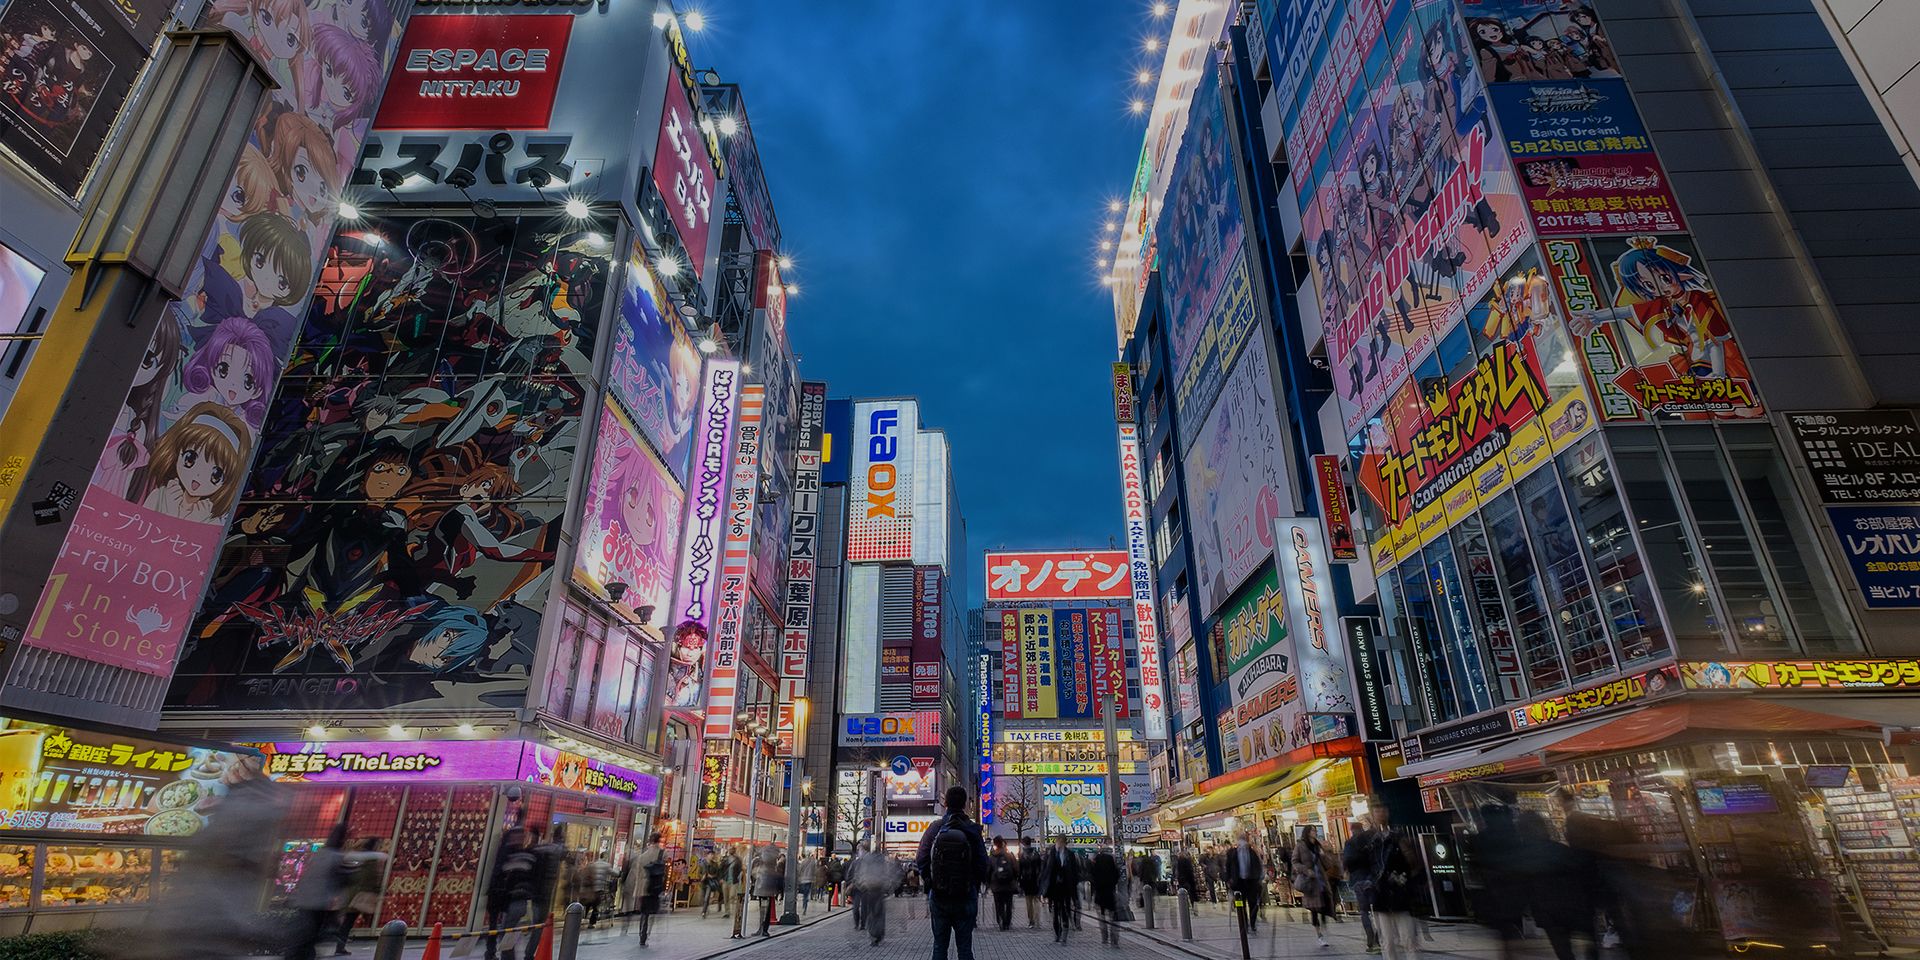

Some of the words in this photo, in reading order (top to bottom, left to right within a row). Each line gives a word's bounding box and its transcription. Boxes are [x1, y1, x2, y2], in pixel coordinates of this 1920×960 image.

[405, 48, 550, 72] ESPACE
[419, 80, 521, 97] NITTAKU
[1528, 115, 1613, 126] ブースターパック
[1530, 128, 1568, 138] BanG
[1572, 126, 1621, 137] Dream!
[1510, 136, 1648, 154] 5月26日(金)発売!
[1531, 195, 1669, 214] 事前登録受付中!
[1538, 213, 1603, 227] 2017年春
[1609, 212, 1675, 225] 配信予定!
[813, 385, 824, 428] HOBBY
[1636, 378, 1752, 408] カードキングダム
[799, 384, 813, 448] PARADISE
[1792, 415, 1838, 425] 不動産の
[1799, 424, 1915, 436] トータルコンサルタント
[738, 425, 757, 466] 買取り
[1380, 341, 1548, 523] カードキングダム
[1122, 444, 1142, 518] TAKARADA
[1865, 489, 1920, 499] 03-6206-9
[1866, 473, 1886, 485] 8F
[731, 487, 751, 537] まっくす
[1847, 534, 1920, 555] レオパレ
[132, 561, 193, 600] BOX
[923, 570, 940, 603] Duty
[991, 553, 1129, 593] オノデン
[1132, 561, 1151, 600] 免税商店
[80, 584, 111, 613] In
[1290, 526, 1329, 655] GAMERS
[67, 613, 166, 660] Stores
[716, 576, 741, 668] アキバ駅前店
[923, 605, 940, 638] Free
[1003, 613, 1017, 642] 免税
[1136, 603, 1160, 687] 歓迎光臨
[1356, 624, 1367, 651] AKIBA
[1004, 643, 1018, 672] TAX
[1243, 655, 1284, 690] AKIHABARA
[1360, 653, 1373, 680] STORE
[980, 654, 989, 706] Panasonic
[1005, 674, 1019, 713] FREE
[1237, 674, 1299, 727] GAMERS
[1364, 681, 1382, 732] ALIENWARE
[1544, 678, 1644, 719] カードキングダム
[982, 712, 991, 757] ONODEN
[1010, 732, 1031, 741] TAX
[1034, 732, 1061, 741] FREE
[1064, 731, 1089, 741] 免税店
[1428, 728, 1460, 745] ALIENWARE
[1460, 724, 1480, 738] STORE
[1481, 719, 1502, 733] AKIBA
[68, 743, 194, 773] 銀座ライオン
[1063, 764, 1094, 772] エアコン
[1044, 783, 1102, 796] ONODEN
[387, 876, 428, 895] AKB48
[432, 875, 473, 894] AKB48
